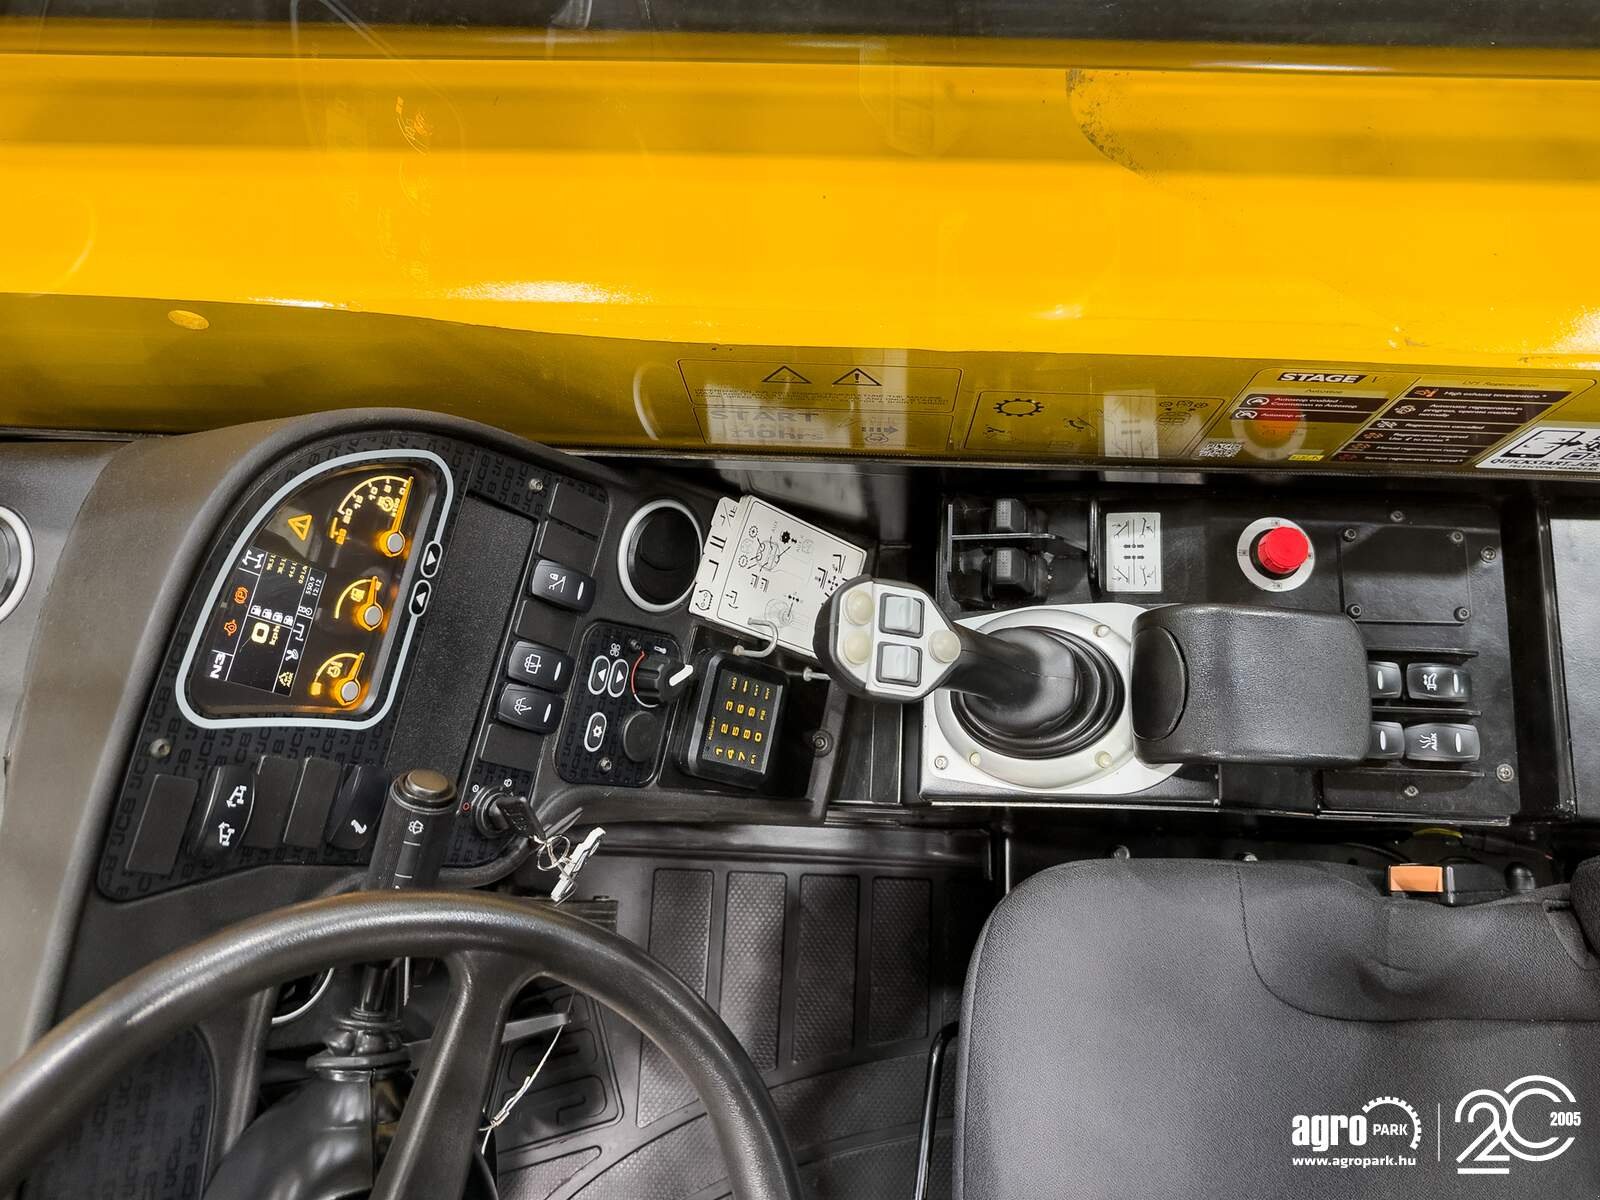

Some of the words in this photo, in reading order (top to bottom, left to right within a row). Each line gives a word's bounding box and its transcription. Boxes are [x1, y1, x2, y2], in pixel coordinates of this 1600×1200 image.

[1281, 373, 1359, 383] STAGE
[710, 410, 820, 422] START
[312, 579, 322, 597] 12:12
[210, 652, 226, 679] N3
[721, 723, 729, 734] 2
[726, 701, 734, 711] 3
[1430, 733, 1438, 751] AUX
[727, 749, 735, 759] 4
[738, 751, 746, 761] 7
